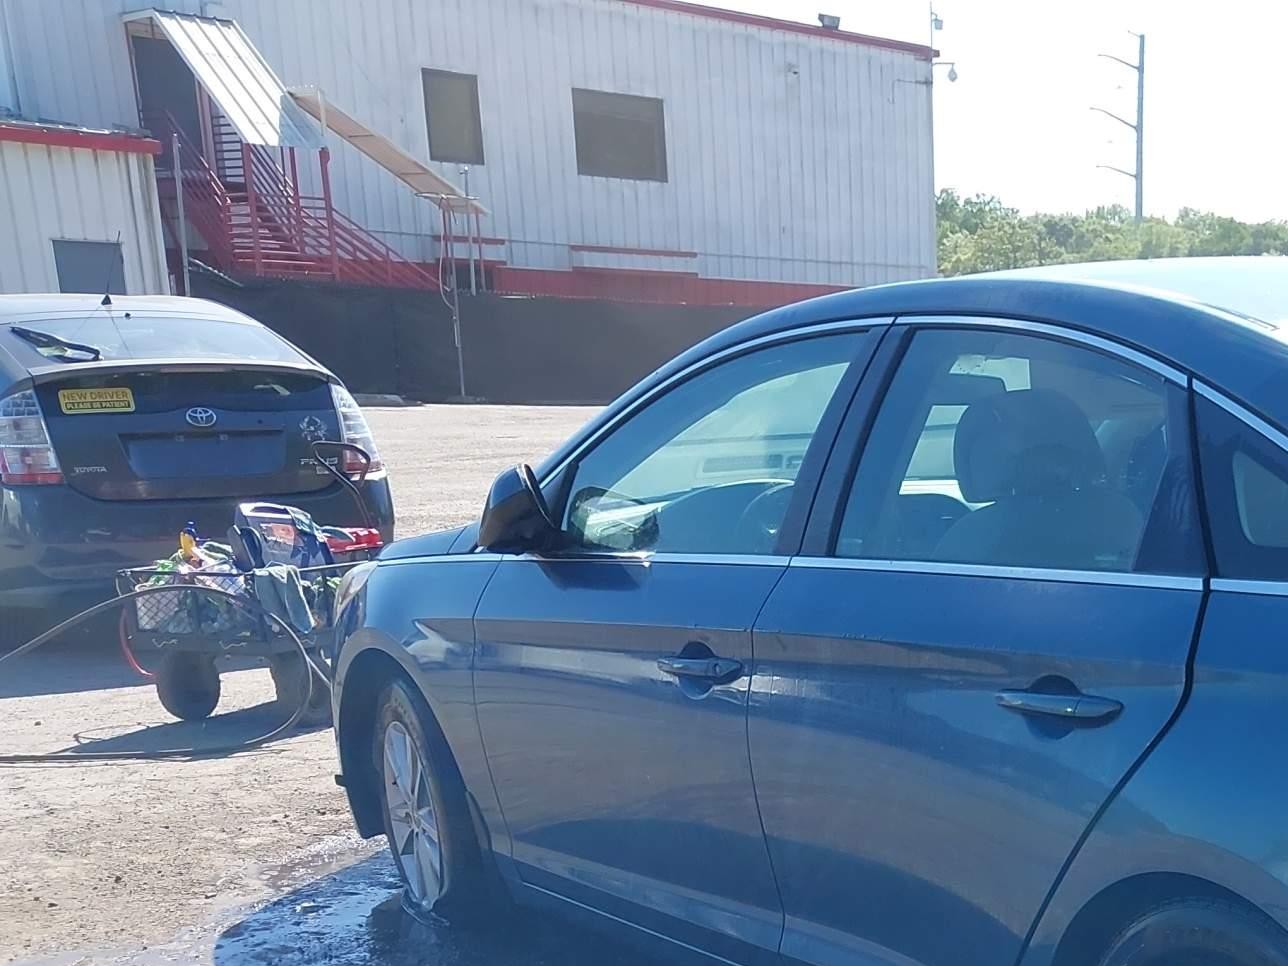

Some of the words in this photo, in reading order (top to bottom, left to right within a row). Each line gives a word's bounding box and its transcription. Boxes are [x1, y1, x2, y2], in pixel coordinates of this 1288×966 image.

[63, 391, 87, 401] NEW
[89, 391, 128, 400] DRIVER
[74, 465, 107, 473] TOYOTA
